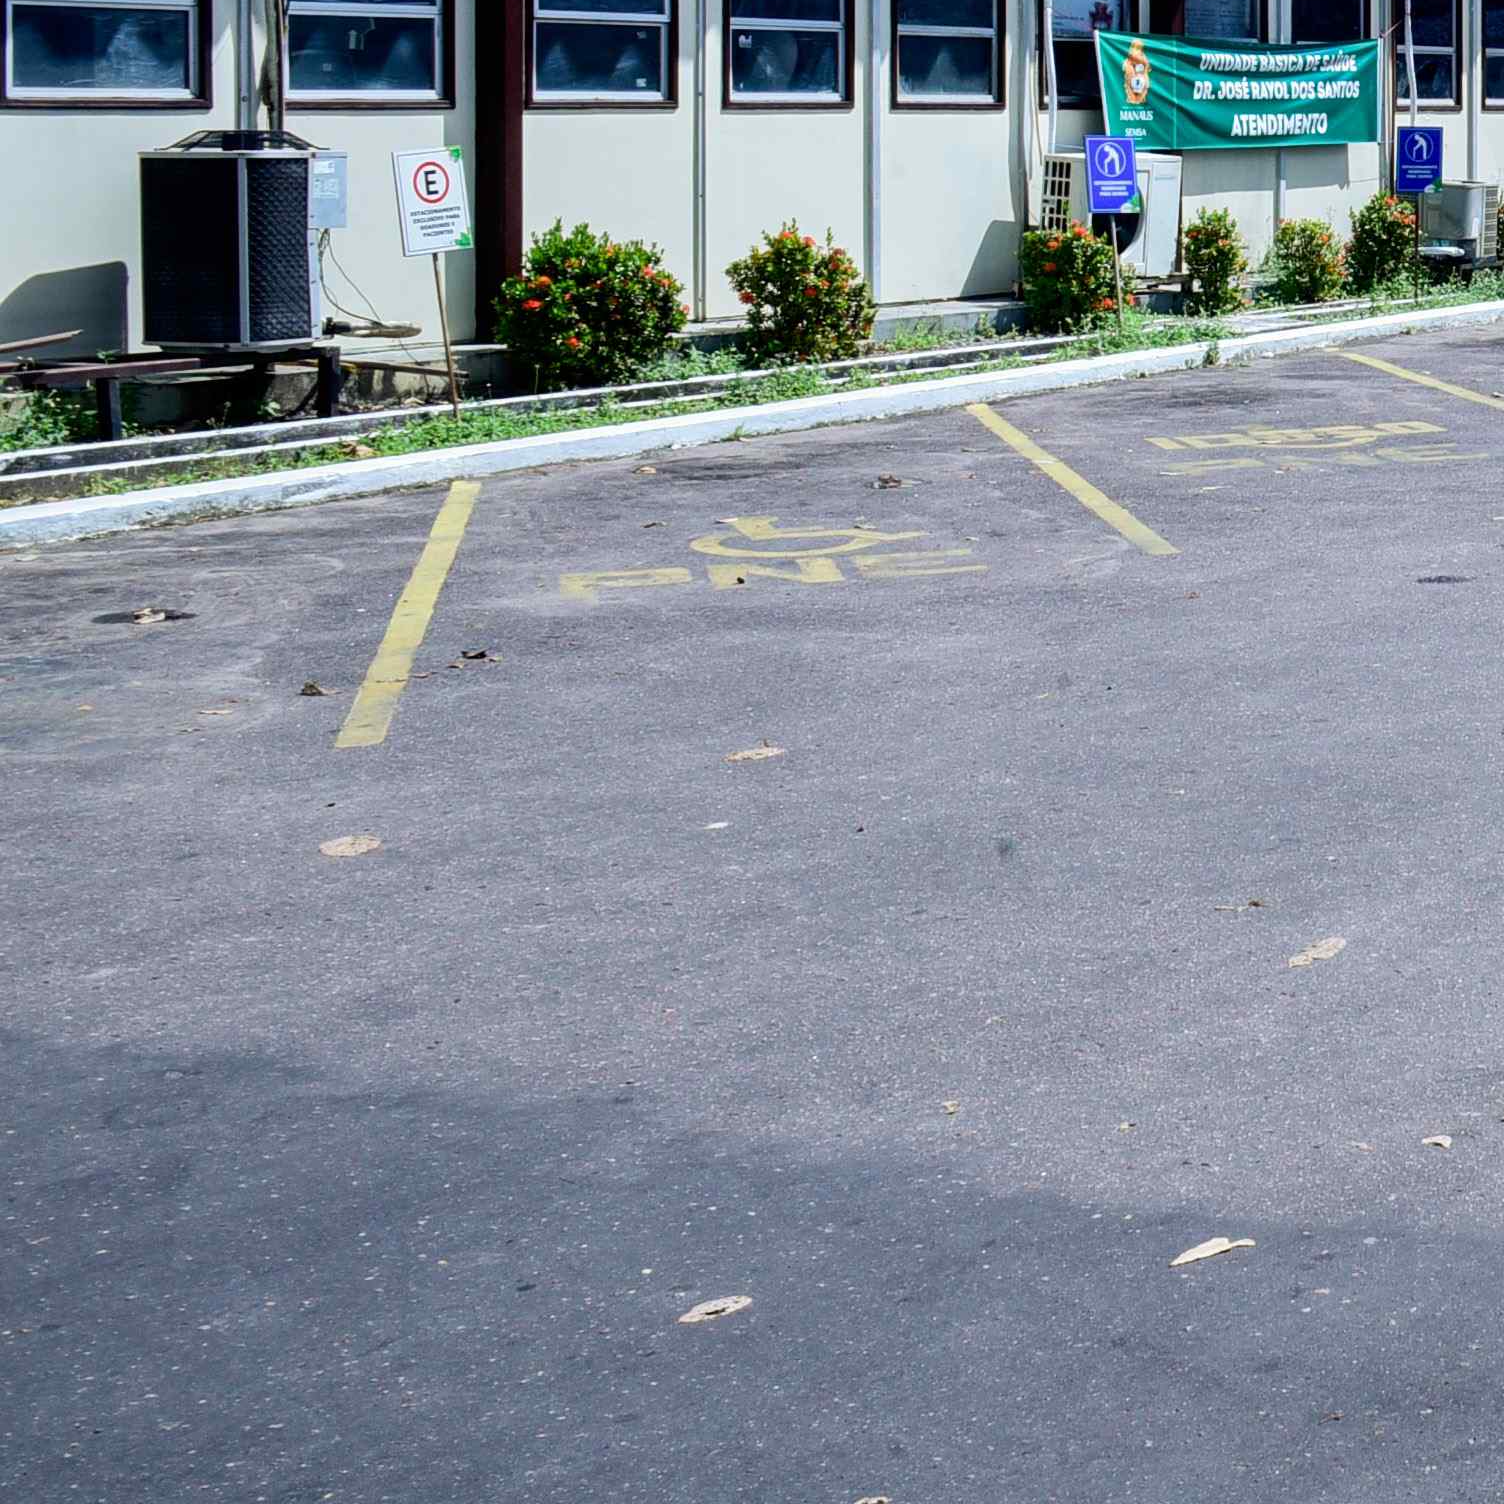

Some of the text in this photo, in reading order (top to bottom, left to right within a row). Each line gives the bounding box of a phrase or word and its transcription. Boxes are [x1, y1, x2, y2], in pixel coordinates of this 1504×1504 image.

[1200, 53, 1258, 72] UNIDADE
[1305, 54, 1319, 72] DE
[1193, 77, 1360, 101] DR. JOSÉ RAYOL DOS SANTOS
[1231, 112, 1329, 137] ATENDIMENTO
[424, 170, 439, 195] E
[560, 548, 988, 601] PNE
